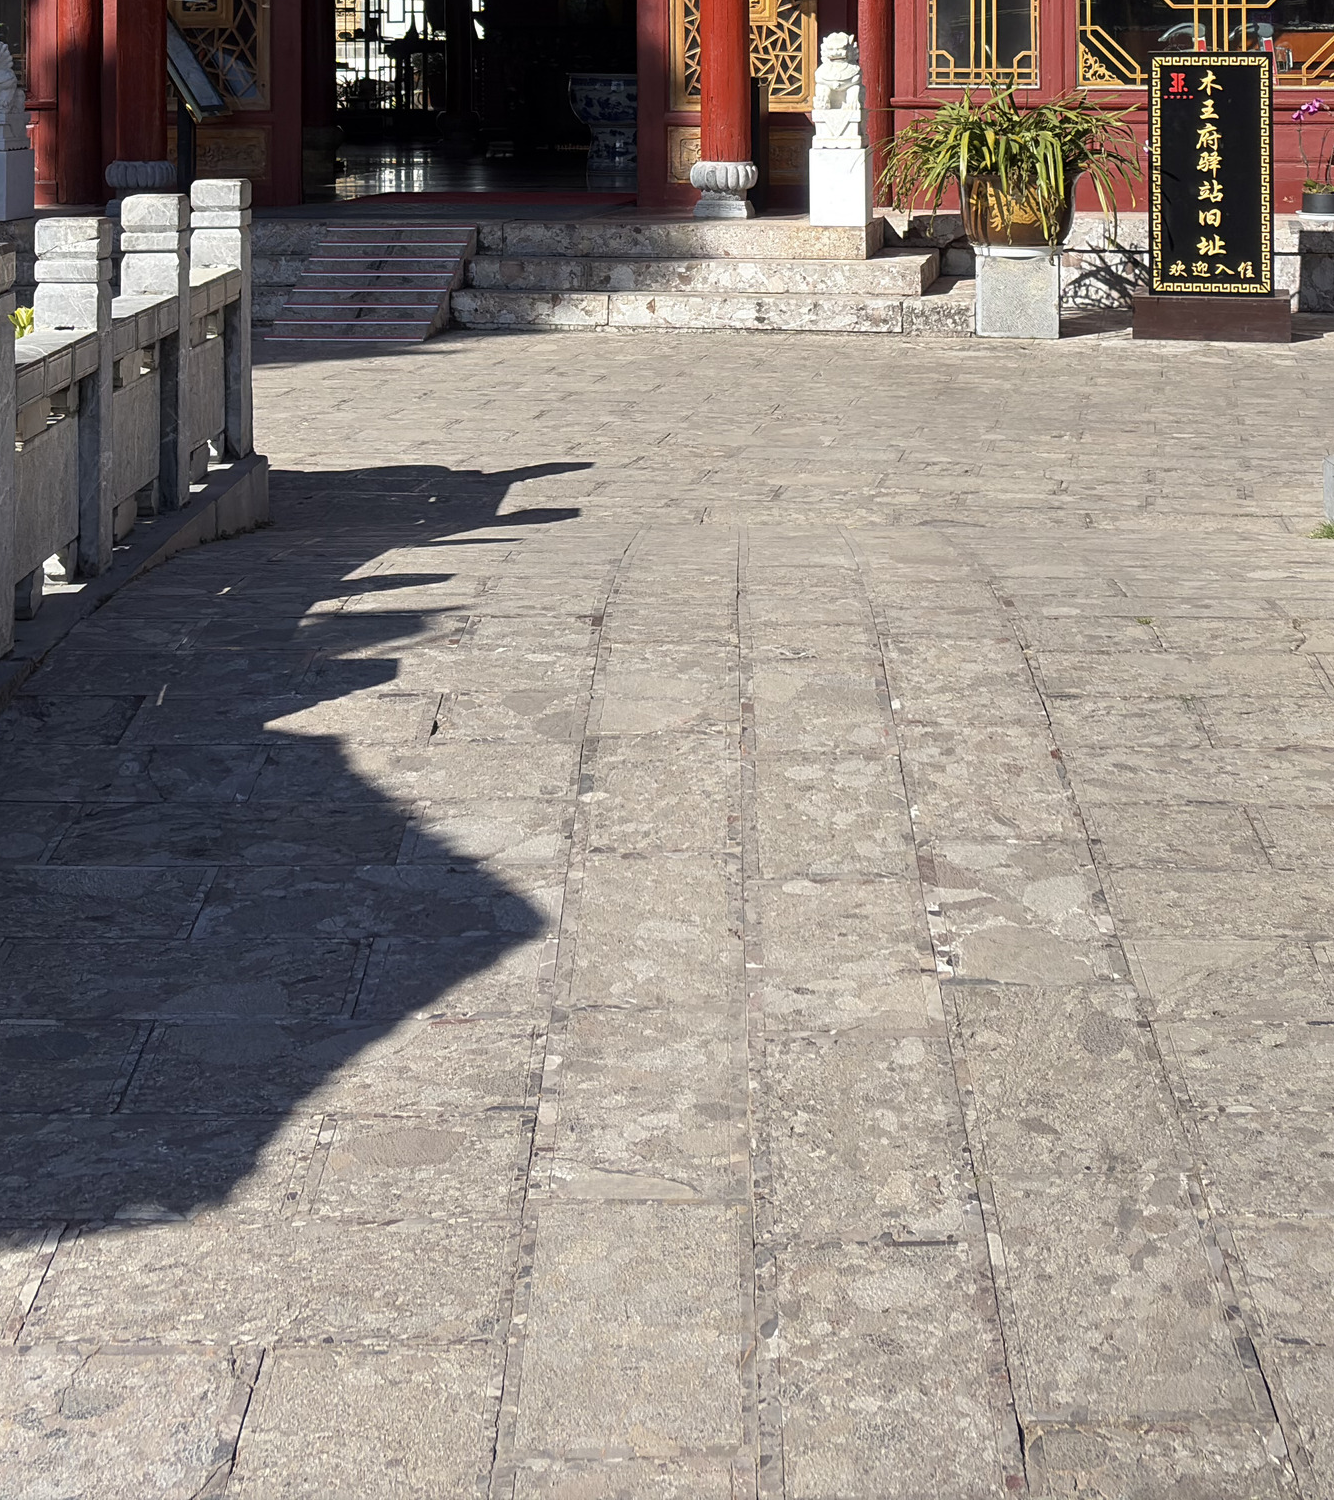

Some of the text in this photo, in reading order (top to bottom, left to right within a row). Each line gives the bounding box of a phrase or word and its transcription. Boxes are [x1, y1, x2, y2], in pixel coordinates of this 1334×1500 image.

[1195, 69, 1227, 256] 木王府驿站旧址
[1168, 260, 1256, 279] 欢迎入住
